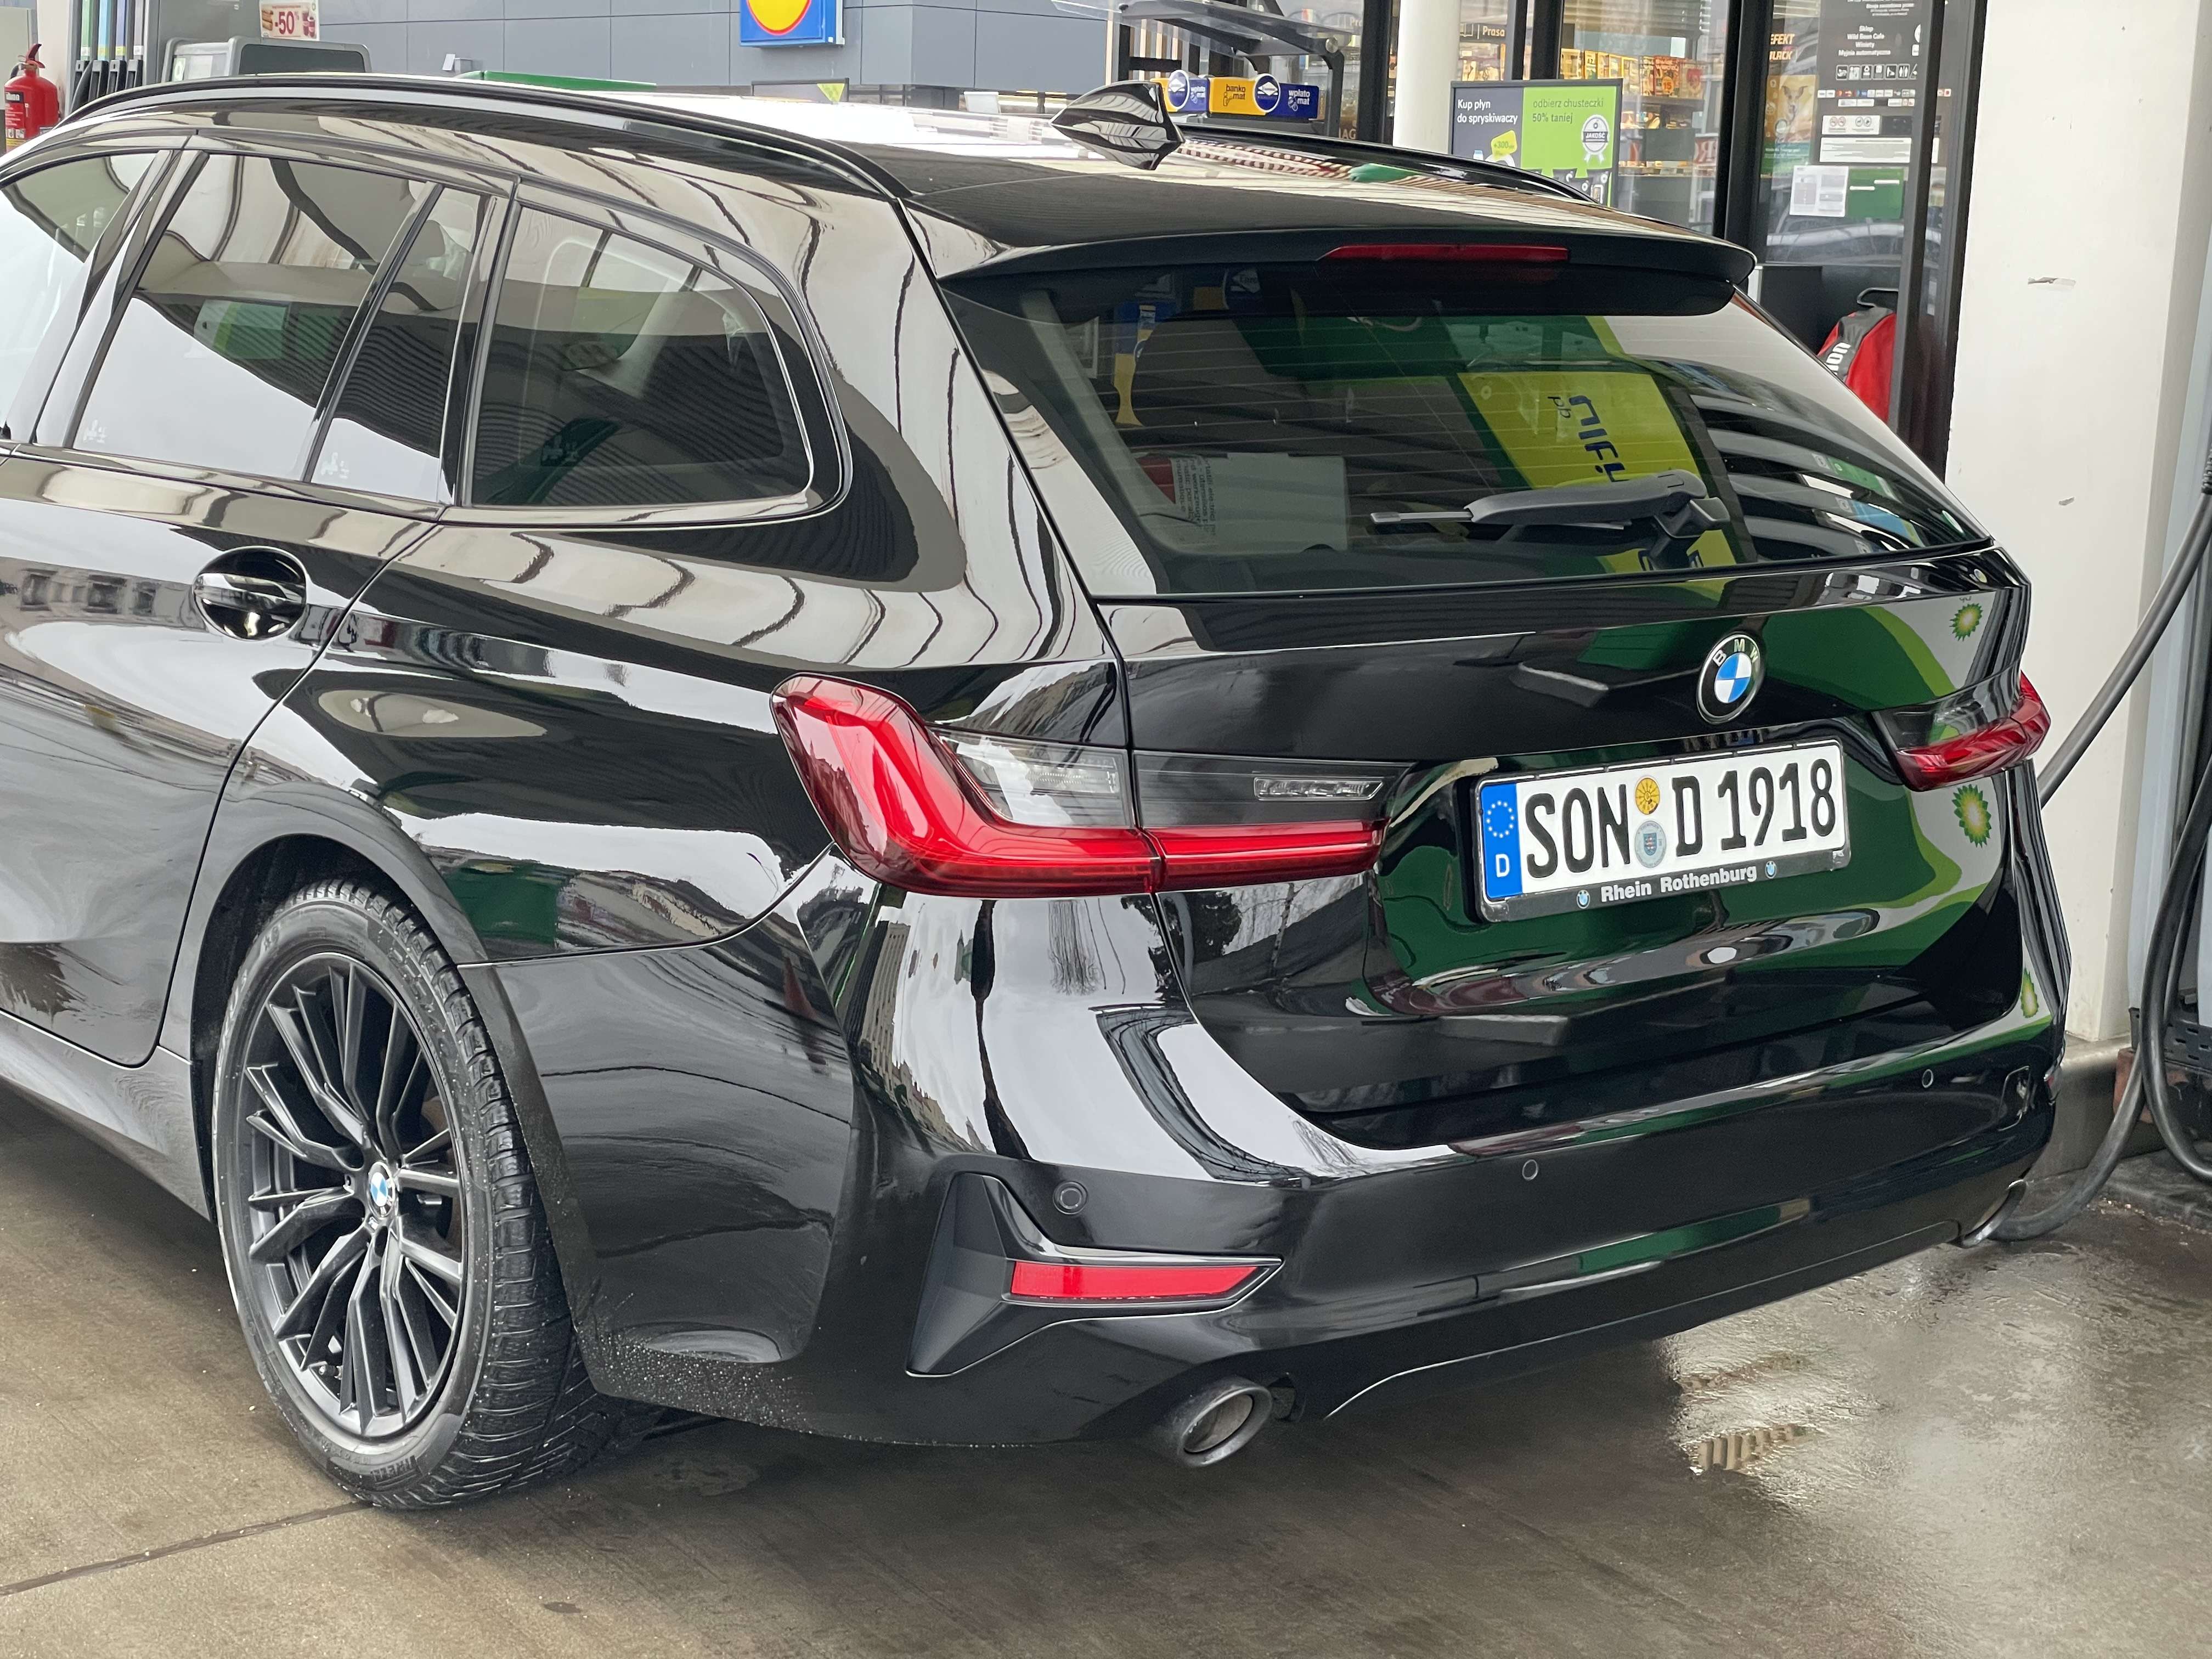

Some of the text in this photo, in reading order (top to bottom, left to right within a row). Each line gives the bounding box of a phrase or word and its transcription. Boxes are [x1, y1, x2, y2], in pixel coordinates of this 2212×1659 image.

[1482, 25, 1505, 37] Prasa
[1226, 84, 1246, 92] banko
[1458, 99, 1491, 111] Kup płyn
[1533, 98, 1604, 108] odbierz chusteczki
[1457, 112, 1518, 125] do spryskiwaczy
[1532, 113, 1573, 124] 50% taniej
[1713, 639, 1758, 667] BMW
[1525, 758, 1836, 878] SON D 1918
[1495, 854, 1510, 878] D
[1600, 865, 1757, 903] Rhein Rothenburg
